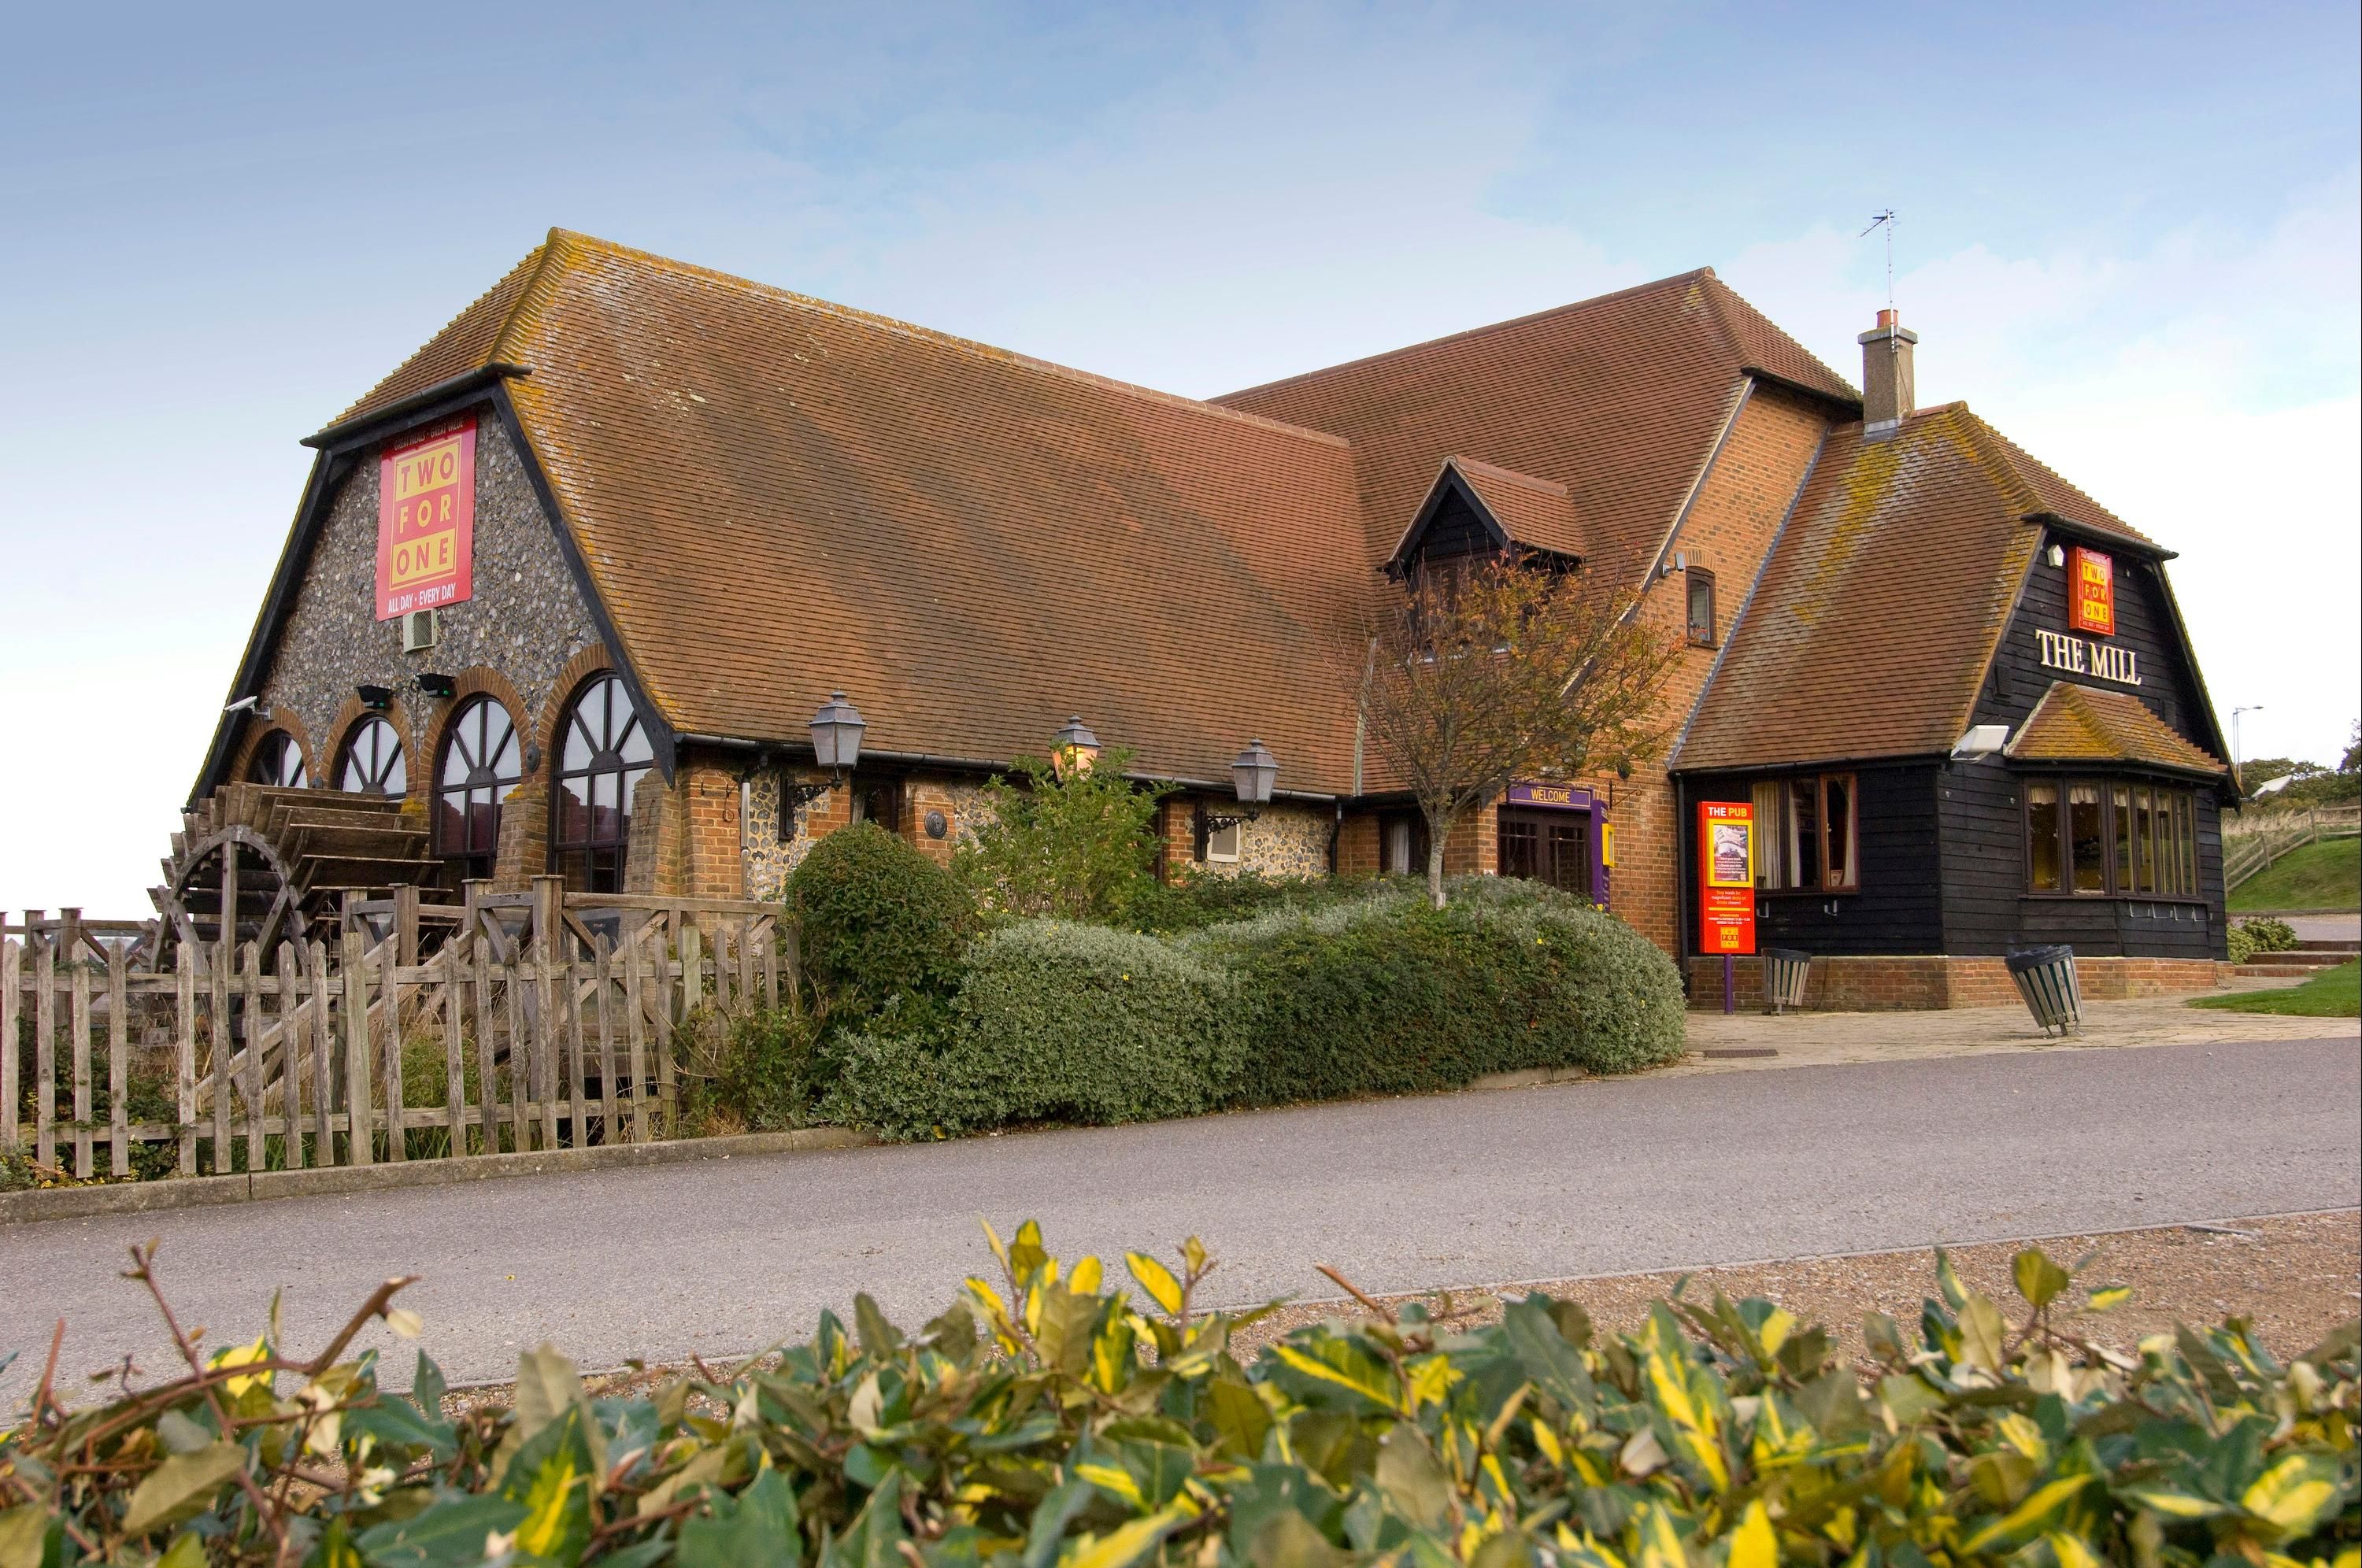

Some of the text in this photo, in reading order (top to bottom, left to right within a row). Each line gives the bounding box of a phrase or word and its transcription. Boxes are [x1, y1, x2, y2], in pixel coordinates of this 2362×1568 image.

[401, 451, 454, 493] TWO
[399, 494, 451, 534] FOR
[396, 538, 449, 576] ONE
[2084, 565, 2105, 582] TWO
[388, 582, 456, 614] ALL DAY EVERY DAY
[2085, 584, 2105, 601] FOR
[2086, 603, 2106, 619] ONE
[2035, 629, 2142, 686] THE MILL
[1531, 789, 1571, 803] WELCOME
[1708, 806, 1747, 817] THE PUB
